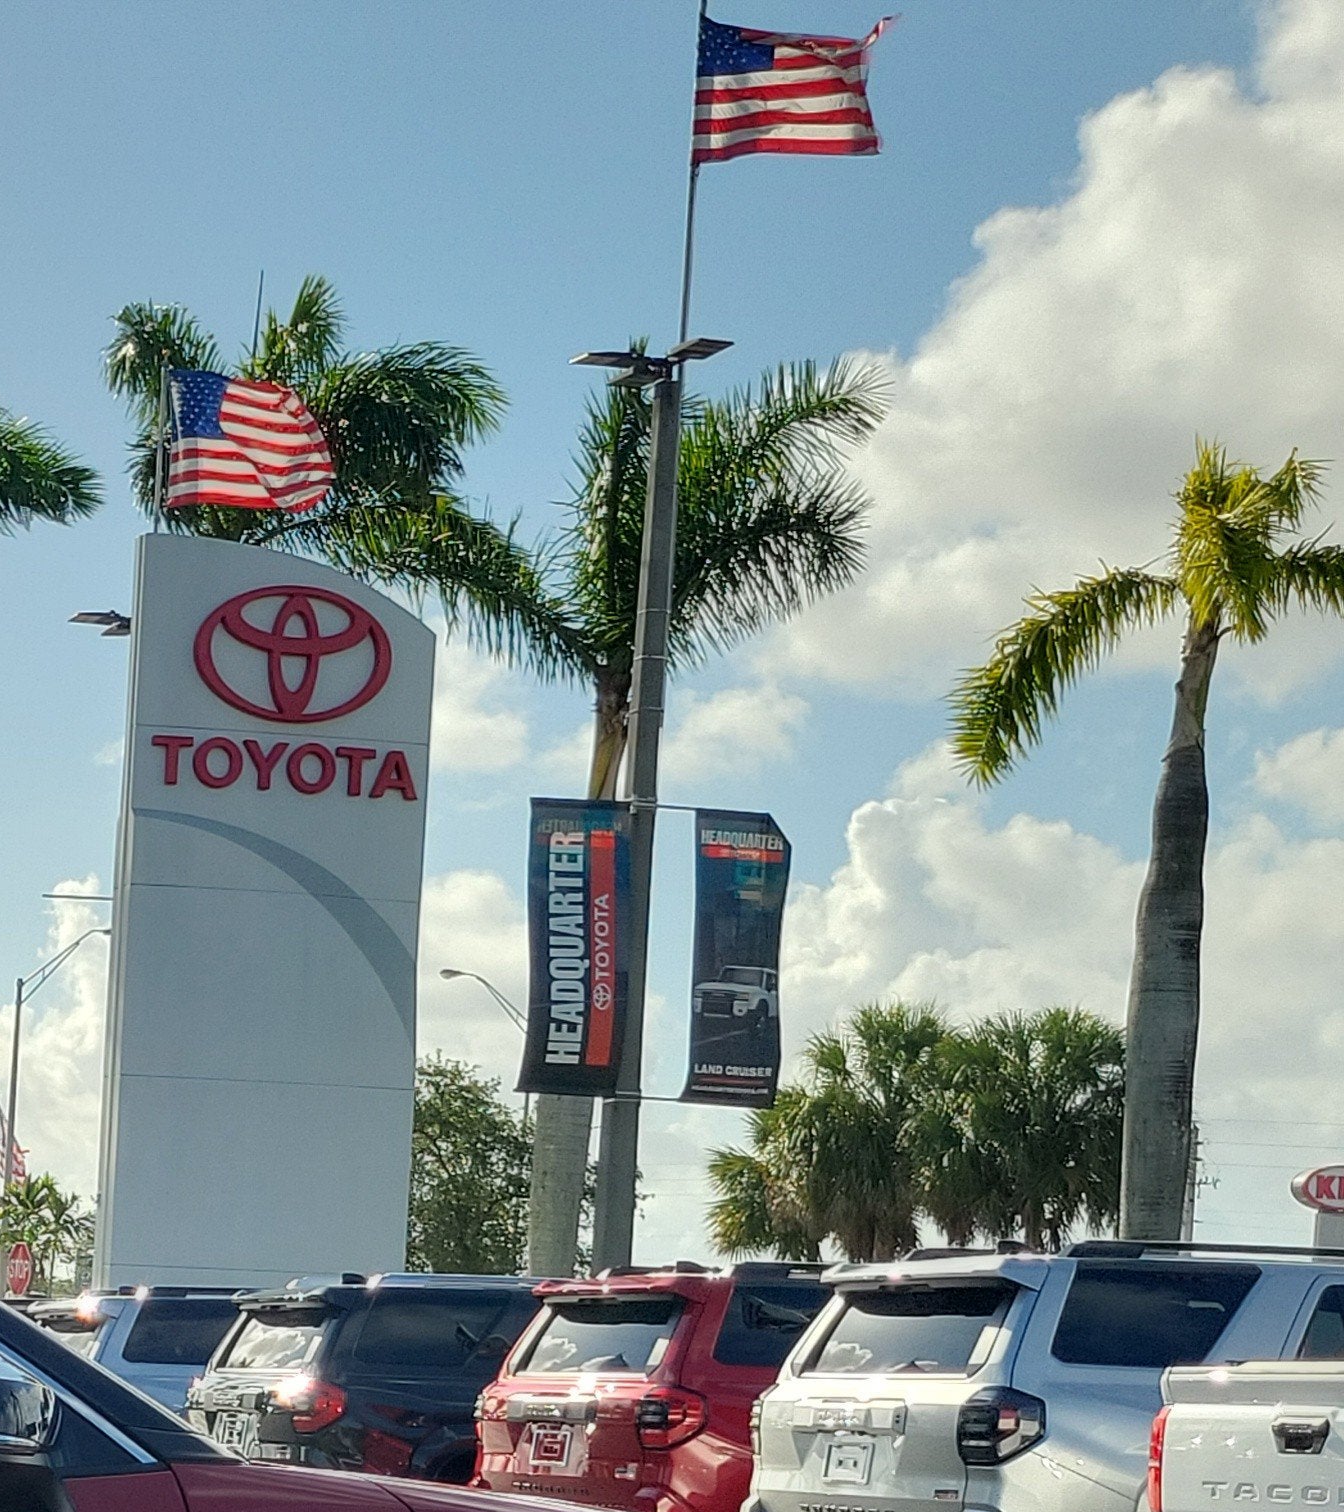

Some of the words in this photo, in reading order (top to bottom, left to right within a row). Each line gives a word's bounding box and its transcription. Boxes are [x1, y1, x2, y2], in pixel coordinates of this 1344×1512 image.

[151, 734, 418, 800] TOYOTA
[701, 829, 784, 851] HEADQUARTER
[545, 830, 591, 1065] HEADQUARTER
[594, 893, 610, 981] TOYOTA
[694, 1063, 723, 1075] LAND
[725, 1065, 772, 1077] CRUISER
[1316, 1174, 1344, 1199] KI
[7, 1259, 29, 1278] STOP
[1202, 1481, 1344, 1506] TACO
